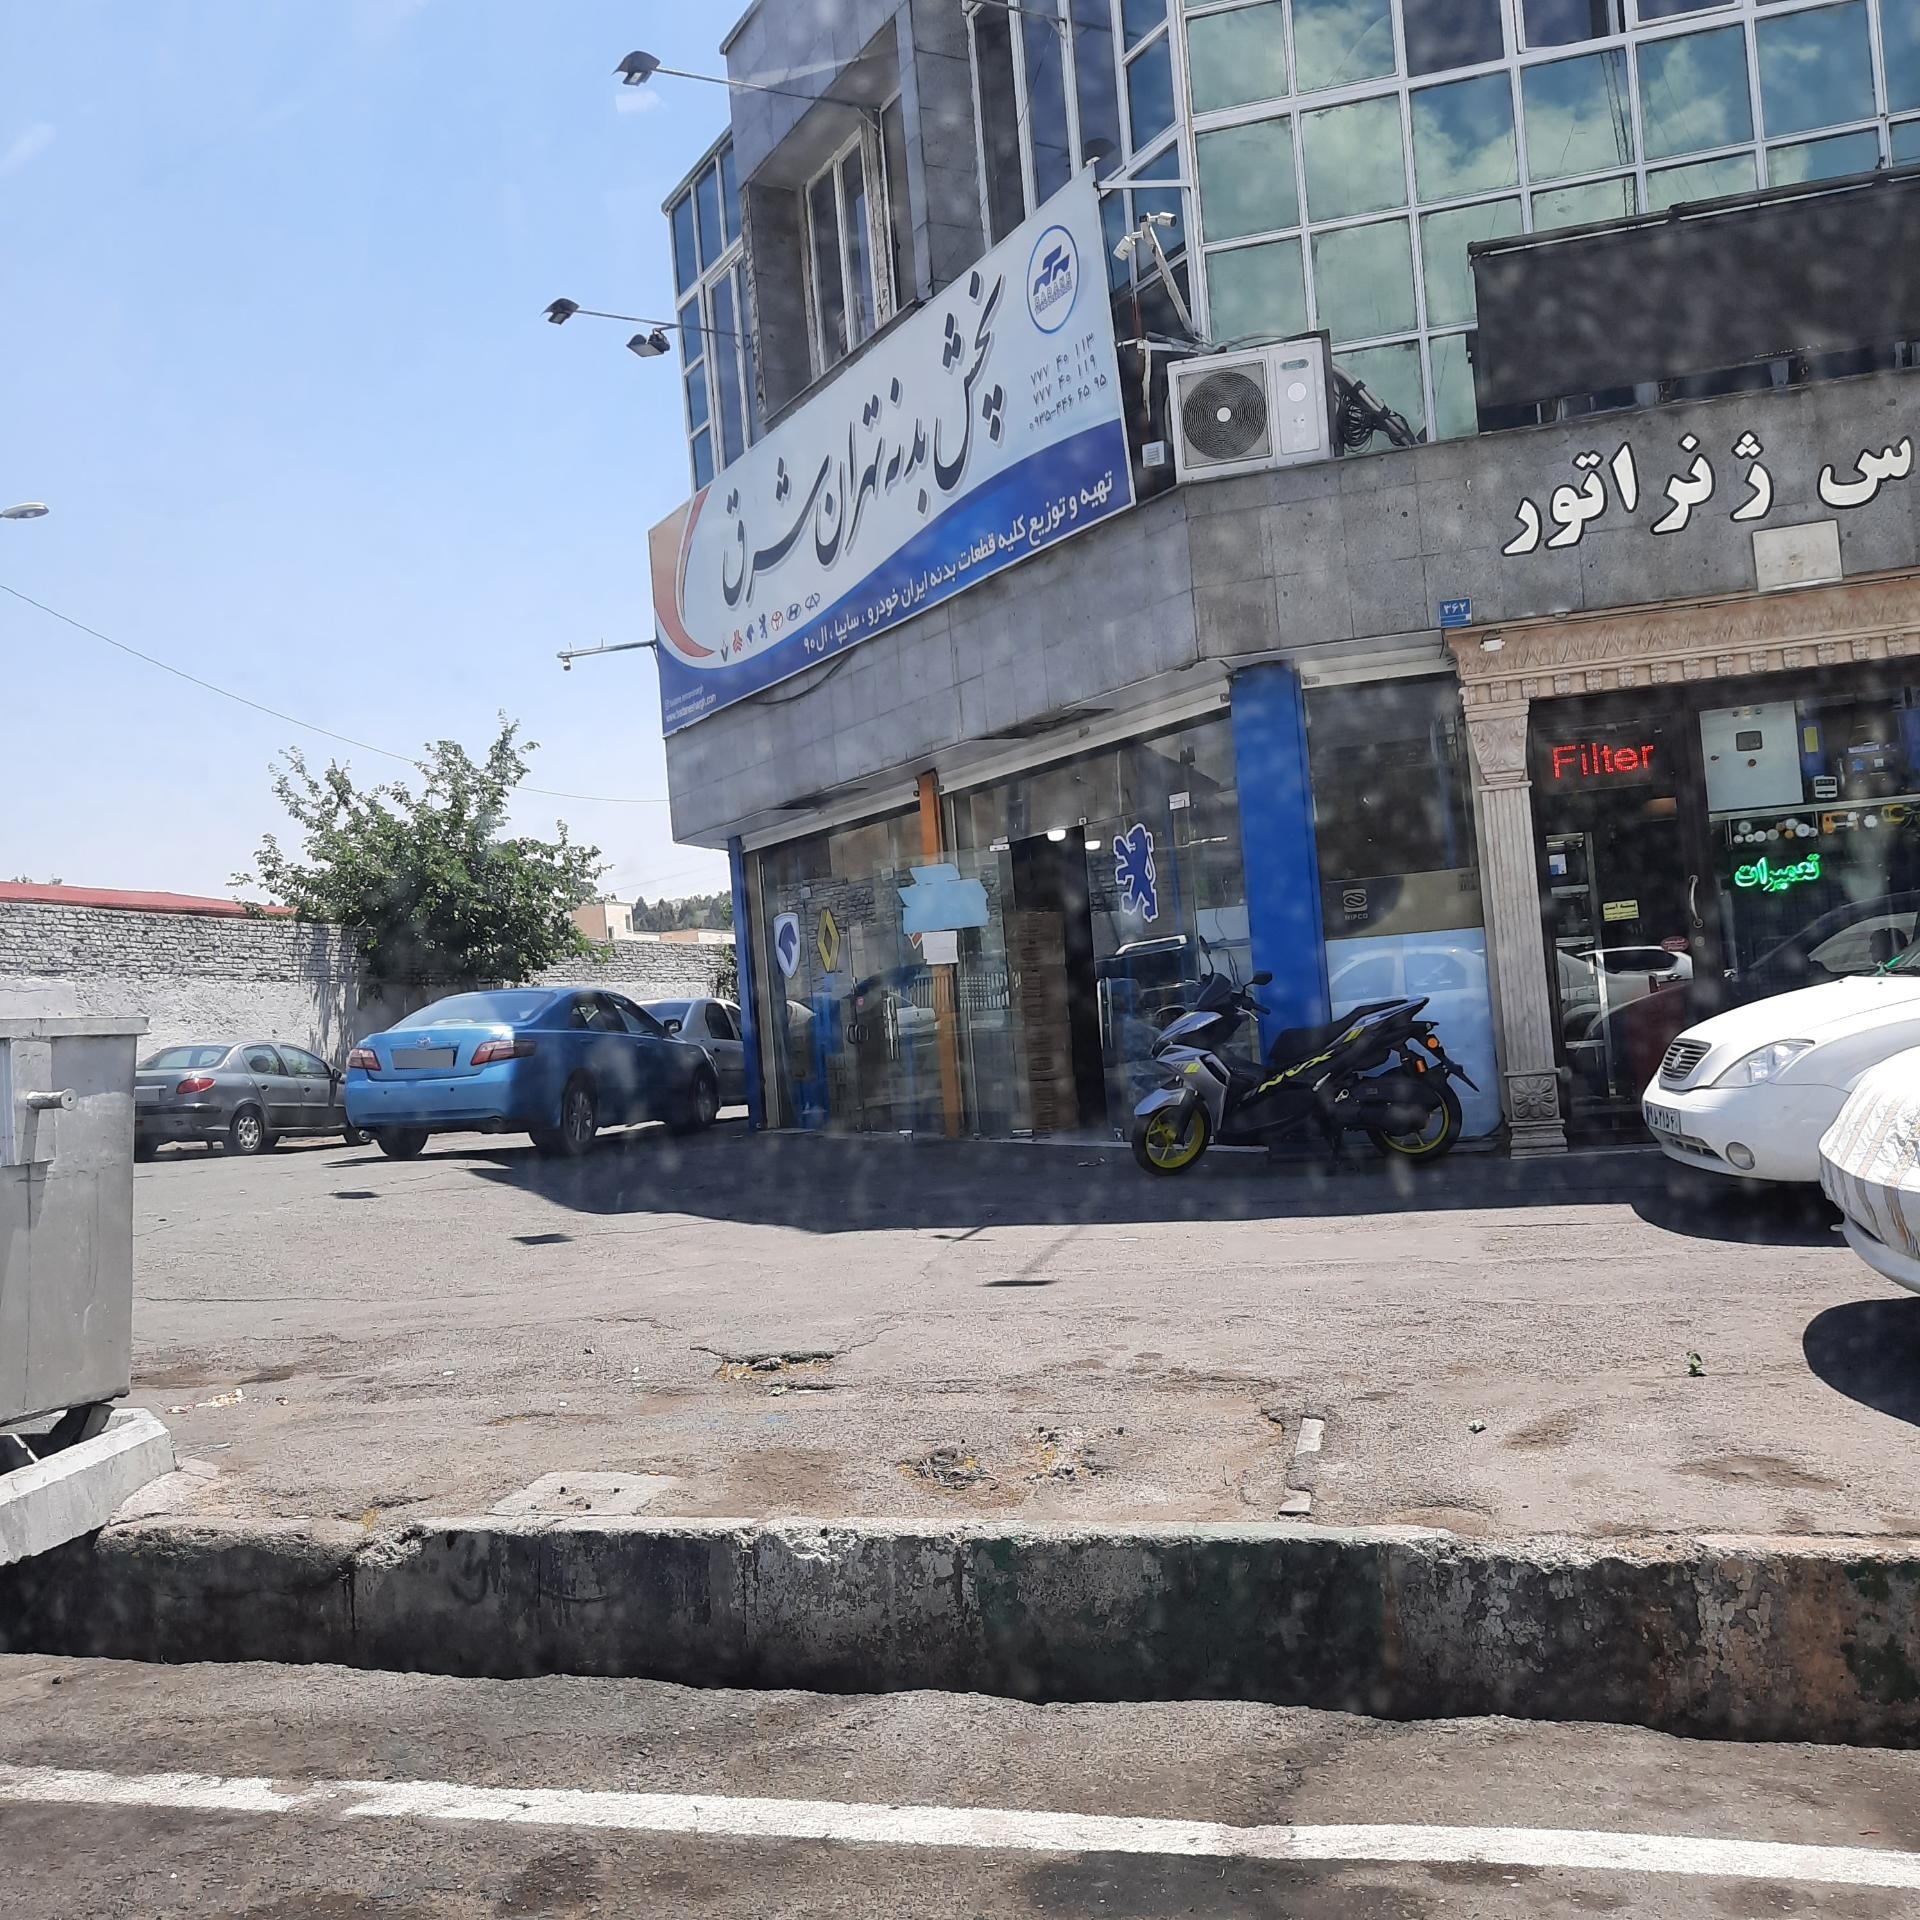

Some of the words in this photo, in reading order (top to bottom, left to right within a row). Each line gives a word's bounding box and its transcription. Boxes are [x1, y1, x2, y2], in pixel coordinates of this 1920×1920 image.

[934, 270, 1003, 492] پخش
[884, 376, 928, 515] بدنه
[814, 393, 884, 567] تهران
[1080, 470, 1113, 506] تهیه
[1501, 430, 1774, 556] ژنراتور
[1028, 496, 1066, 547] توزیع
[1069, 496, 1078, 520] و
[722, 454, 831, 607] شرق
[998, 514, 1026, 553] کلیه
[958, 532, 996, 572] قطعات
[901, 570, 928, 608] ایران
[930, 563, 956, 588] بدنه
[868, 588, 899, 627] خودرو
[834, 614, 860, 645] سایپا
[1552, 742, 1655, 779] Filter
[1734, 853, 1821, 892] تعمیرات
